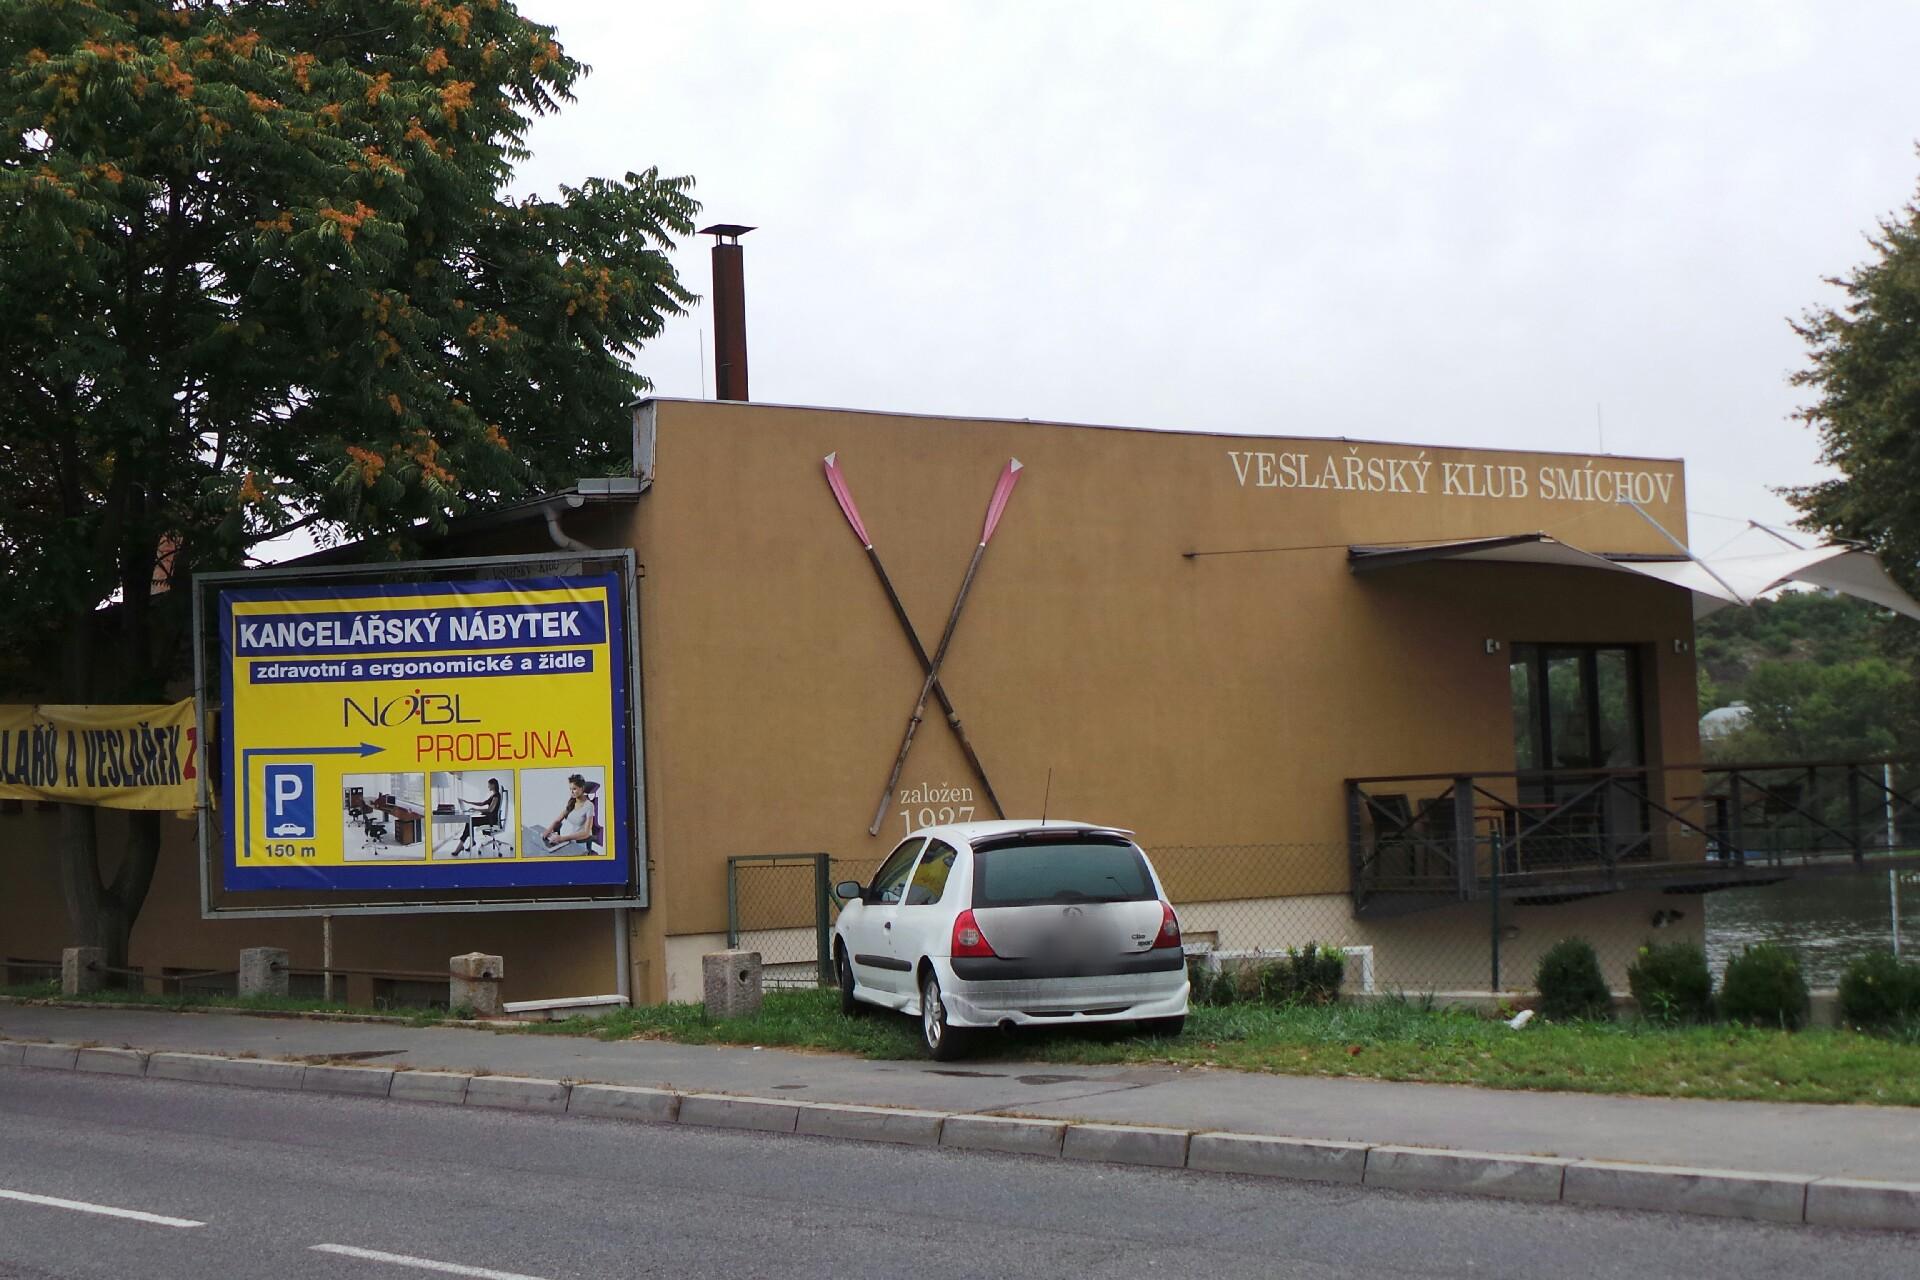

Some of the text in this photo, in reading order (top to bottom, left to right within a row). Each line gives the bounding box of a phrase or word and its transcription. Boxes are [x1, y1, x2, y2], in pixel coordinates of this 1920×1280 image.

[1228, 447, 1675, 504] VESLAŘSKÝ KLUB SMÍCHOV
[240, 611, 581, 649] KANCELÁŘSKÝ NÁBYTEK
[257, 652, 586, 679] zdravotní a ergonomické a židle
[0, 722, 58, 788] LAŘŮ
[66, 730, 79, 788] A
[82, 721, 181, 788] VESLAŘEK
[416, 730, 574, 763] PRODEJNA
[275, 774, 303, 816] P
[900, 782, 973, 804] založen
[265, 844, 316, 859] 150 m
